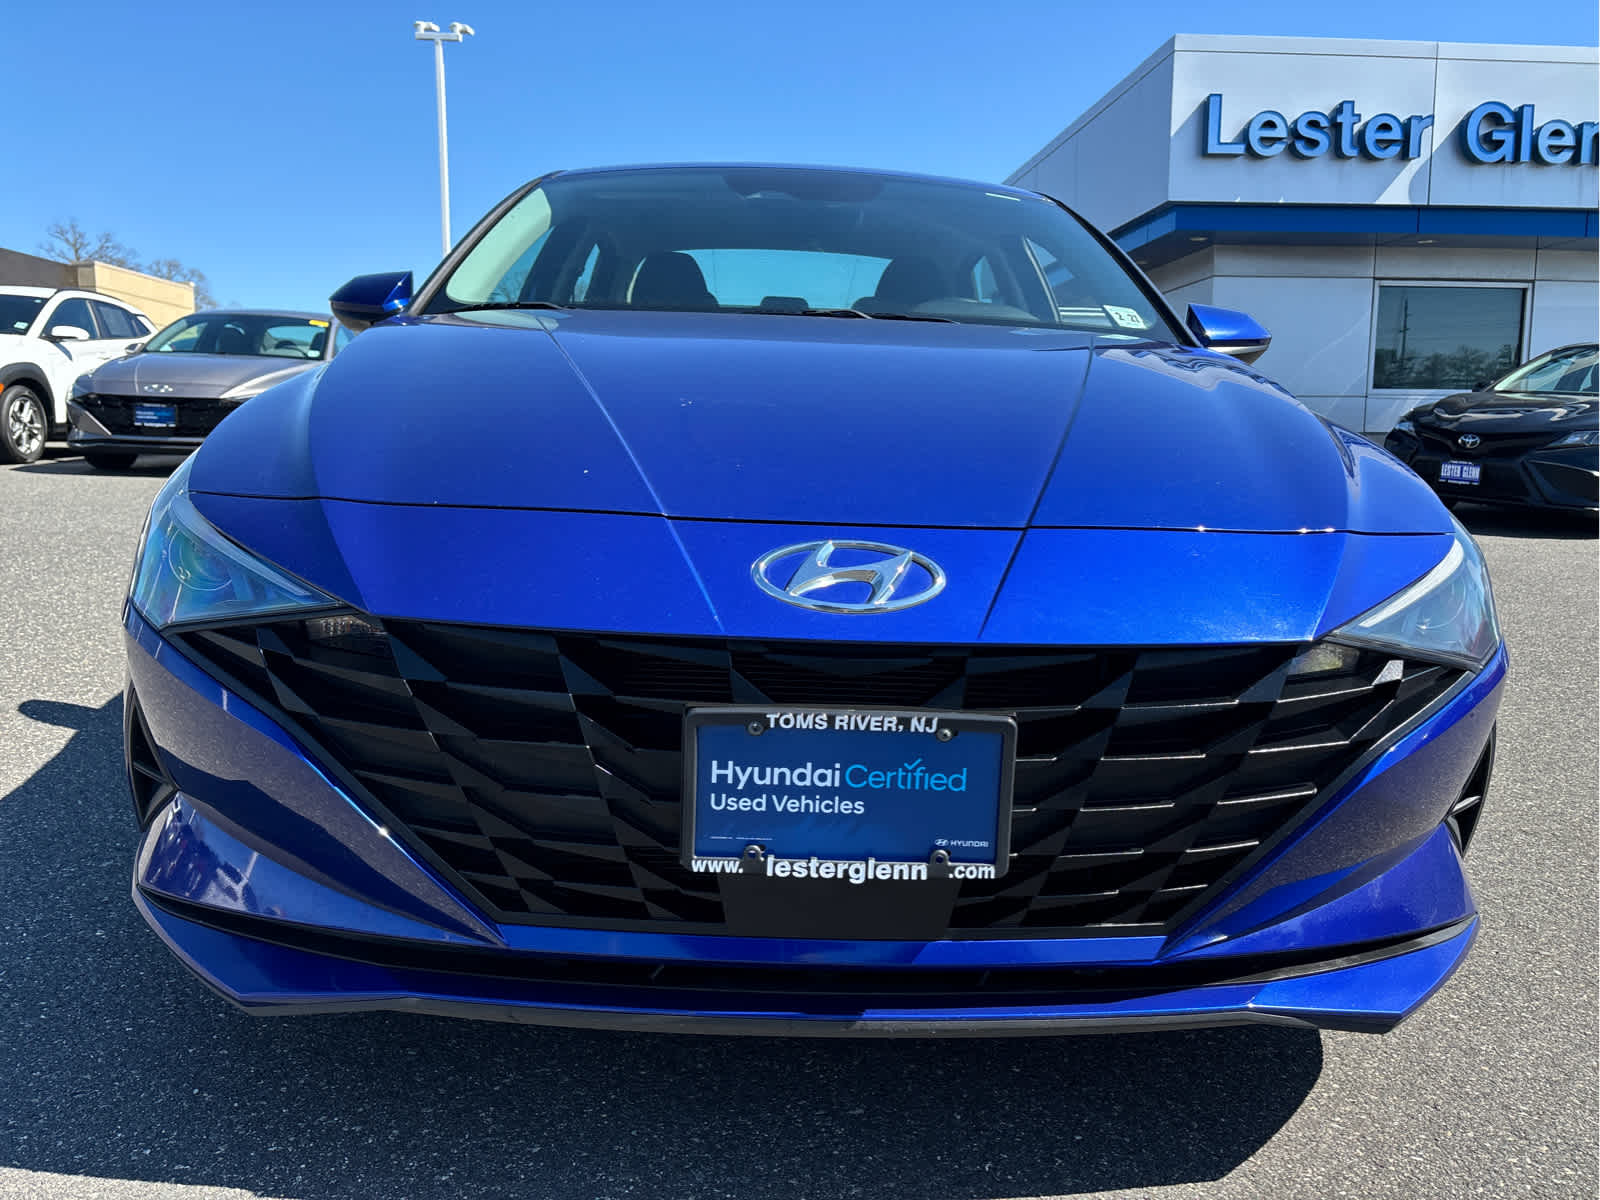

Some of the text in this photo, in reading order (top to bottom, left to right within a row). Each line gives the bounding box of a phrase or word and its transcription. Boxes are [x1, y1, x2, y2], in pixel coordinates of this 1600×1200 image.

[1203, 93, 1434, 160] Lester
[766, 712, 939, 734] TOMS RIVER, NJ
[711, 759, 968, 792] Hyundai Certified
[710, 793, 865, 815] Used Vehicles
[950, 839, 989, 848] HYUNDAI
[691, 855, 996, 884] www. lesterglenn .com
